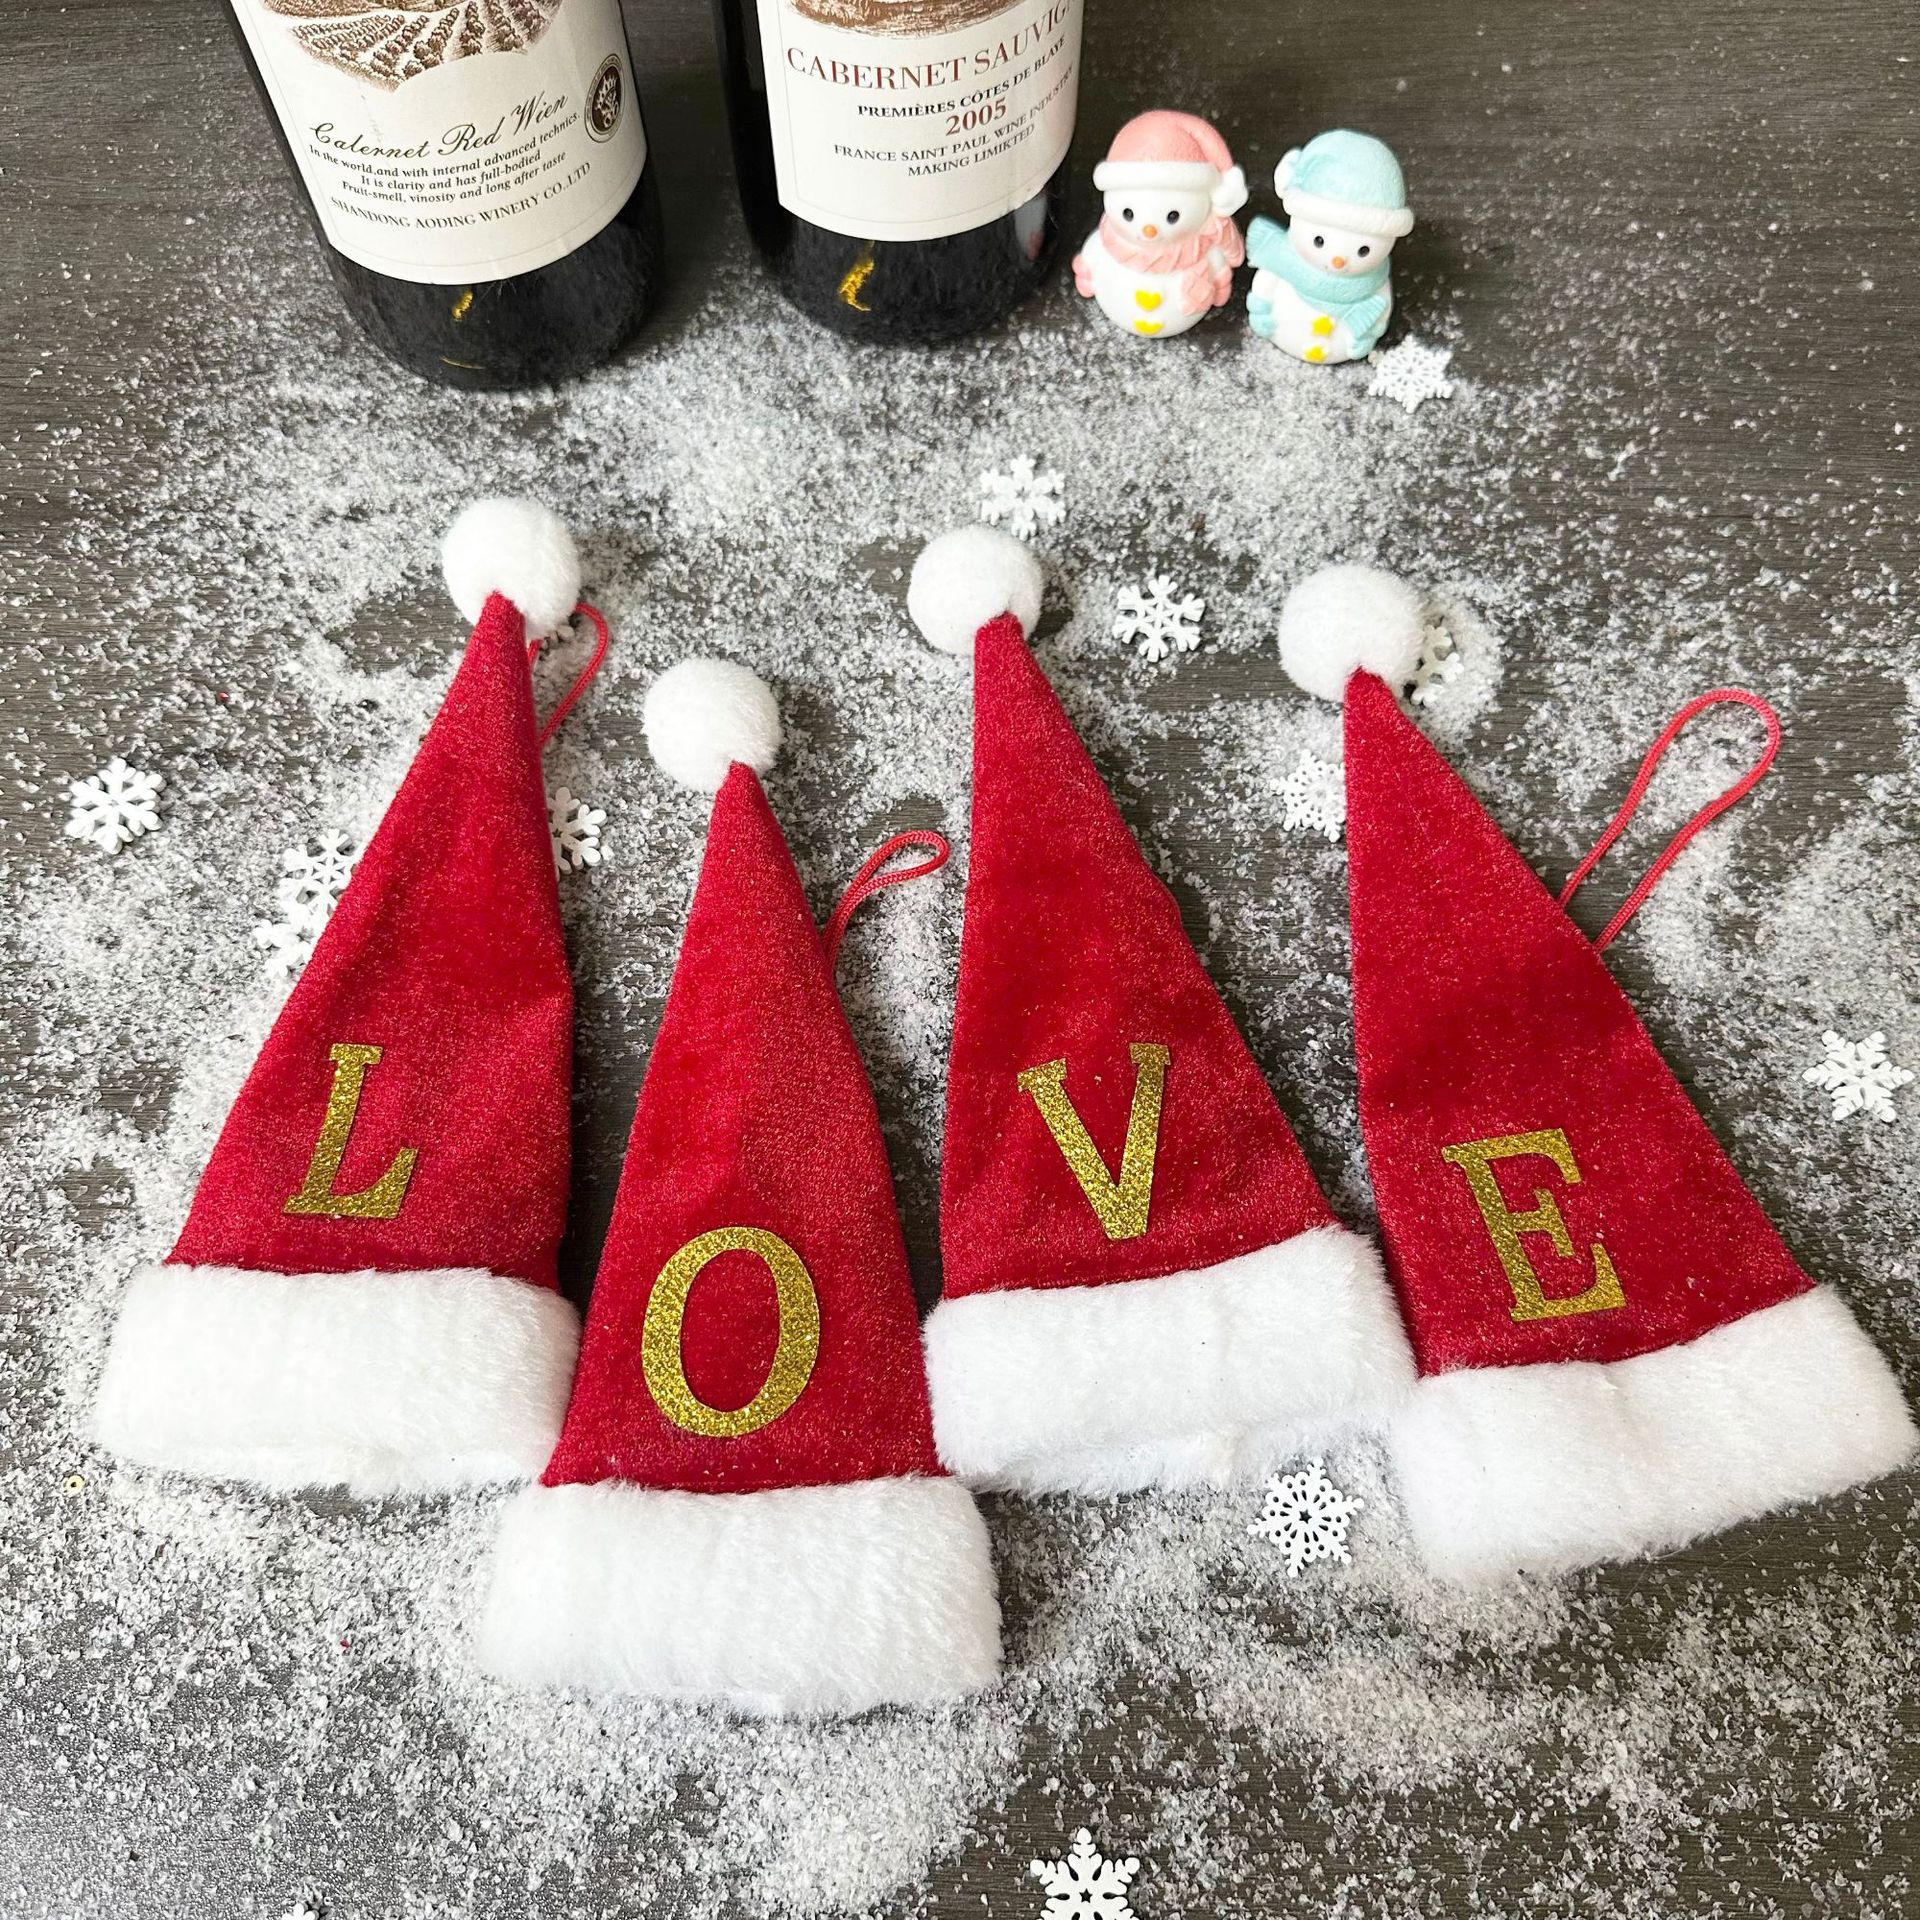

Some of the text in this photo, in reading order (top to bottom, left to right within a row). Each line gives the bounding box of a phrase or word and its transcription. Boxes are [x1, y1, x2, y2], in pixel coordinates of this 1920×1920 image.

[787, 47, 966, 90] CABERNET
[858, 31, 1066, 118] PREMIÈRES CÔTES DE BLAYE
[438, 116, 506, 156] Red
[510, 90, 568, 136] Wien
[833, 144, 897, 162] FRANCE
[900, 146, 950, 161] SAINT
[952, 134, 990, 154] PAUL
[994, 114, 1027, 138] WINE
[945, 96, 1007, 137] 2005
[309, 144, 321, 158] In
[322, 151, 339, 165] the
[402, 166, 429, 178] with
[432, 157, 481, 176] internal
[484, 136, 537, 167] advanced
[361, 149, 541, 193] It is clarity and has full-bodied
[409, 192, 456, 204] vinosity
[459, 185, 483, 200] and
[486, 179, 512, 195] long
[514, 167, 540, 185] after
[542, 151, 566, 172] taste
[907, 159, 970, 177] MAKING
[331, 196, 411, 228] SHANDONG
[479, 191, 541, 222] WINERY
[282, 1043, 418, 1219] L
[1016, 1042, 1171, 1240] V
[1441, 1128, 1627, 1322] E
[641, 1226, 821, 1438] O
